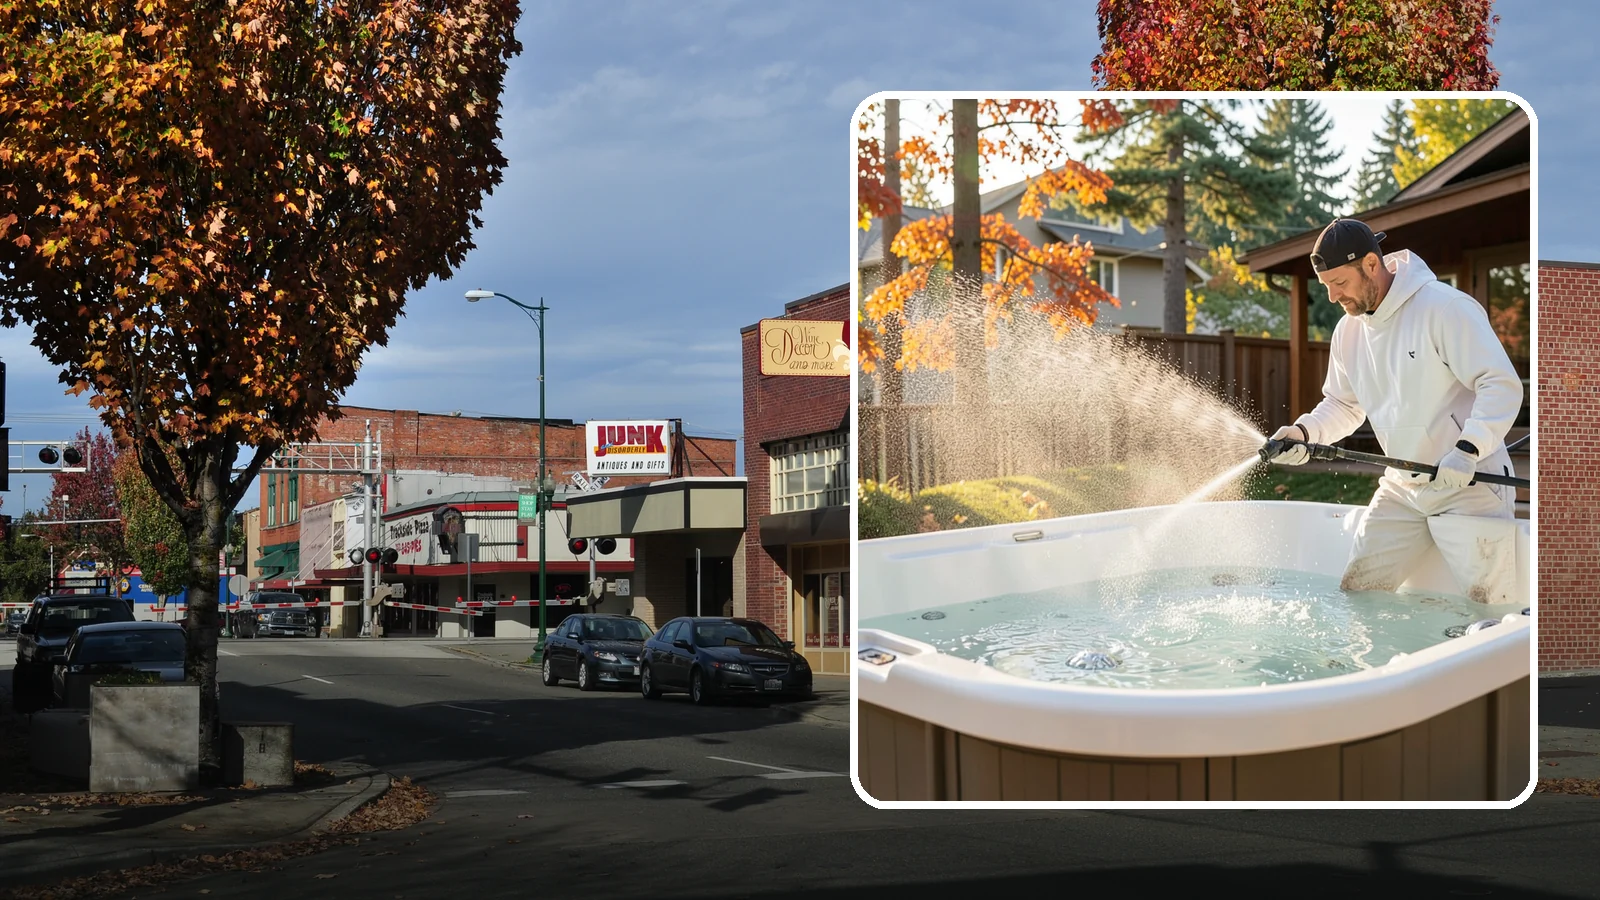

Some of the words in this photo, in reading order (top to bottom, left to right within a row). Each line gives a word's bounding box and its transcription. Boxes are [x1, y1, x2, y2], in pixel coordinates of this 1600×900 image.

[765, 327, 831, 366] Decor
[595, 425, 665, 457] JUNK
[607, 446, 646, 454] DISORDERLY
[597, 461, 628, 470] ANTIQUES
[631, 461, 644, 470] AND
[646, 460, 665, 470] GIFTS
[352, 498, 365, 511] CRO
[414, 519, 429, 535] Pizza
